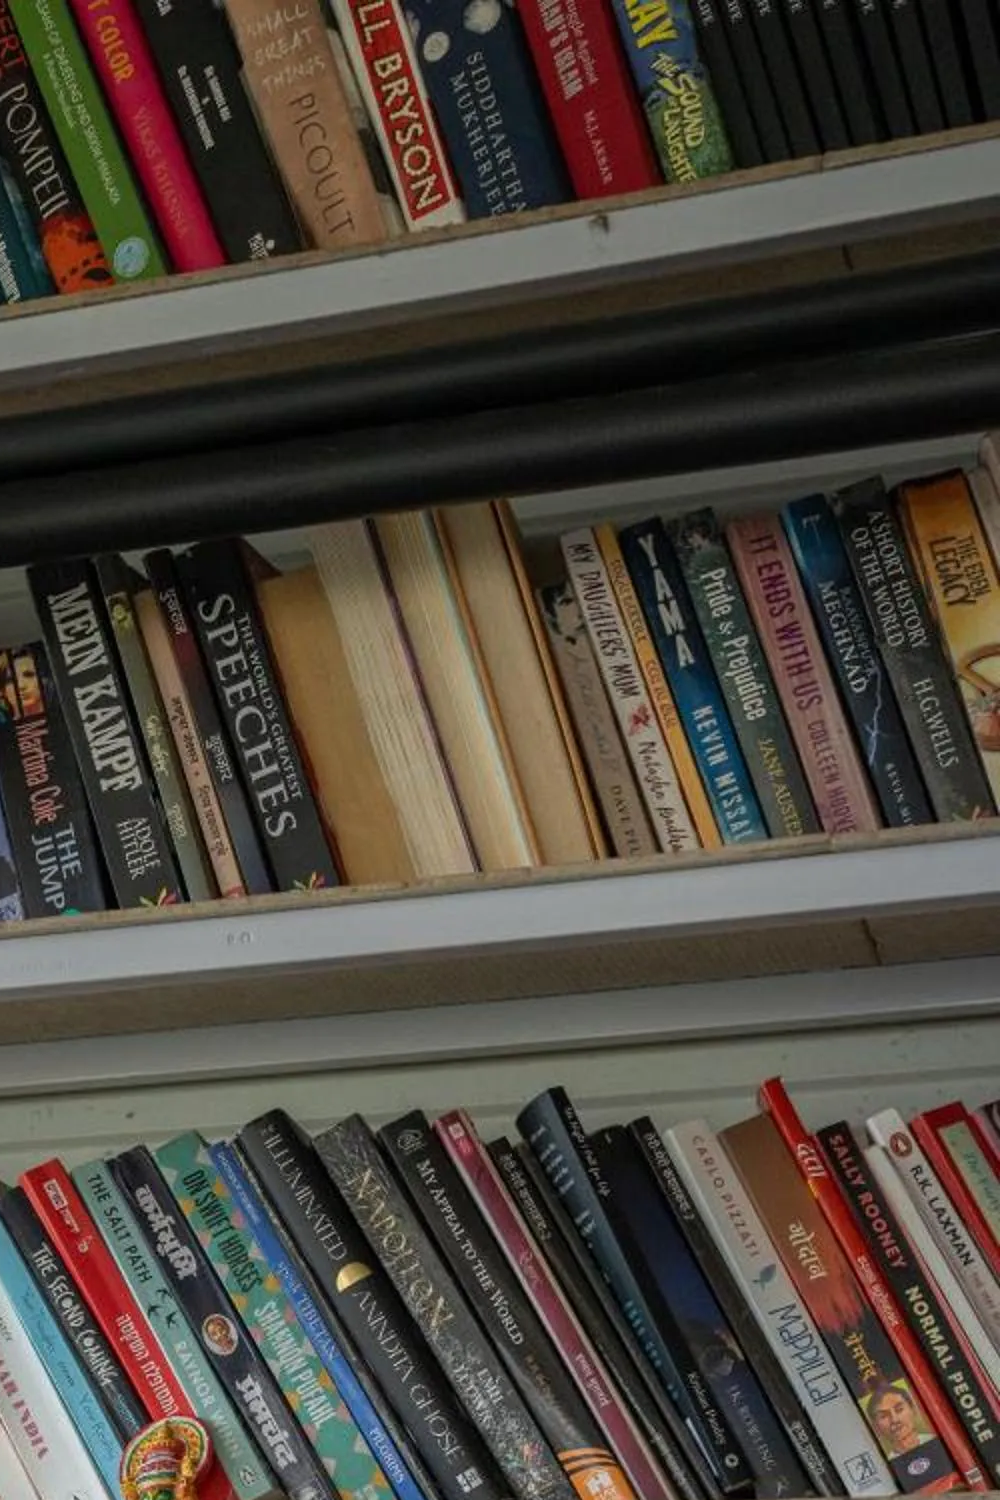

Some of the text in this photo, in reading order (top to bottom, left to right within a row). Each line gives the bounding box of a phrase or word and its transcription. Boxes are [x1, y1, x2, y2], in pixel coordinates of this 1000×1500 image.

[98, 15, 135, 83] COLOR
[290, 93, 354, 234] PICOULT
[374, 56, 443, 210] BRYSON
[637, 533, 696, 668] YAMA
[874, 590, 904, 647] WORLD
[893, 578, 929, 650] HISTORY
[928, 536, 977, 606] LEGACY
[609, 655, 641, 699] MUM
[702, 567, 767, 722] Pride Prejudice
[757, 559, 823, 713] ENDS WITH US
[816, 581, 868, 694] MEGHNAD
[48, 583, 144, 792] MEIN KAMPF
[198, 592, 297, 839] SPEECHES
[269, 722, 302, 800] GREATEST
[694, 706, 719, 766] KEVIN
[32, 835, 66, 909] JUMP
[53, 827, 82, 875] THE
[115, 820, 145, 881] HITLER
[131, 818, 161, 871] ADOLF
[262, 1132, 348, 1263] ILLUMINATED
[691, 1134, 761, 1262] CARLO PIZZATI
[827, 1133, 908, 1268] SALLY ROONEY
[928, 1198, 975, 1268] LAXMAN
[122, 1243, 153, 1284] PATH
[218, 1236, 264, 1292] HORSES
[786, 1221, 827, 1281] गोदान
[42, 1272, 77, 1330] SECOND
[72, 1330, 114, 1387] COMING
[254, 1300, 338, 1430] SHANNON PUFAHL
[352, 1288, 465, 1462] ANINDITA GHOSE
[905, 1285, 993, 1444] NORMAL PEOPLE
